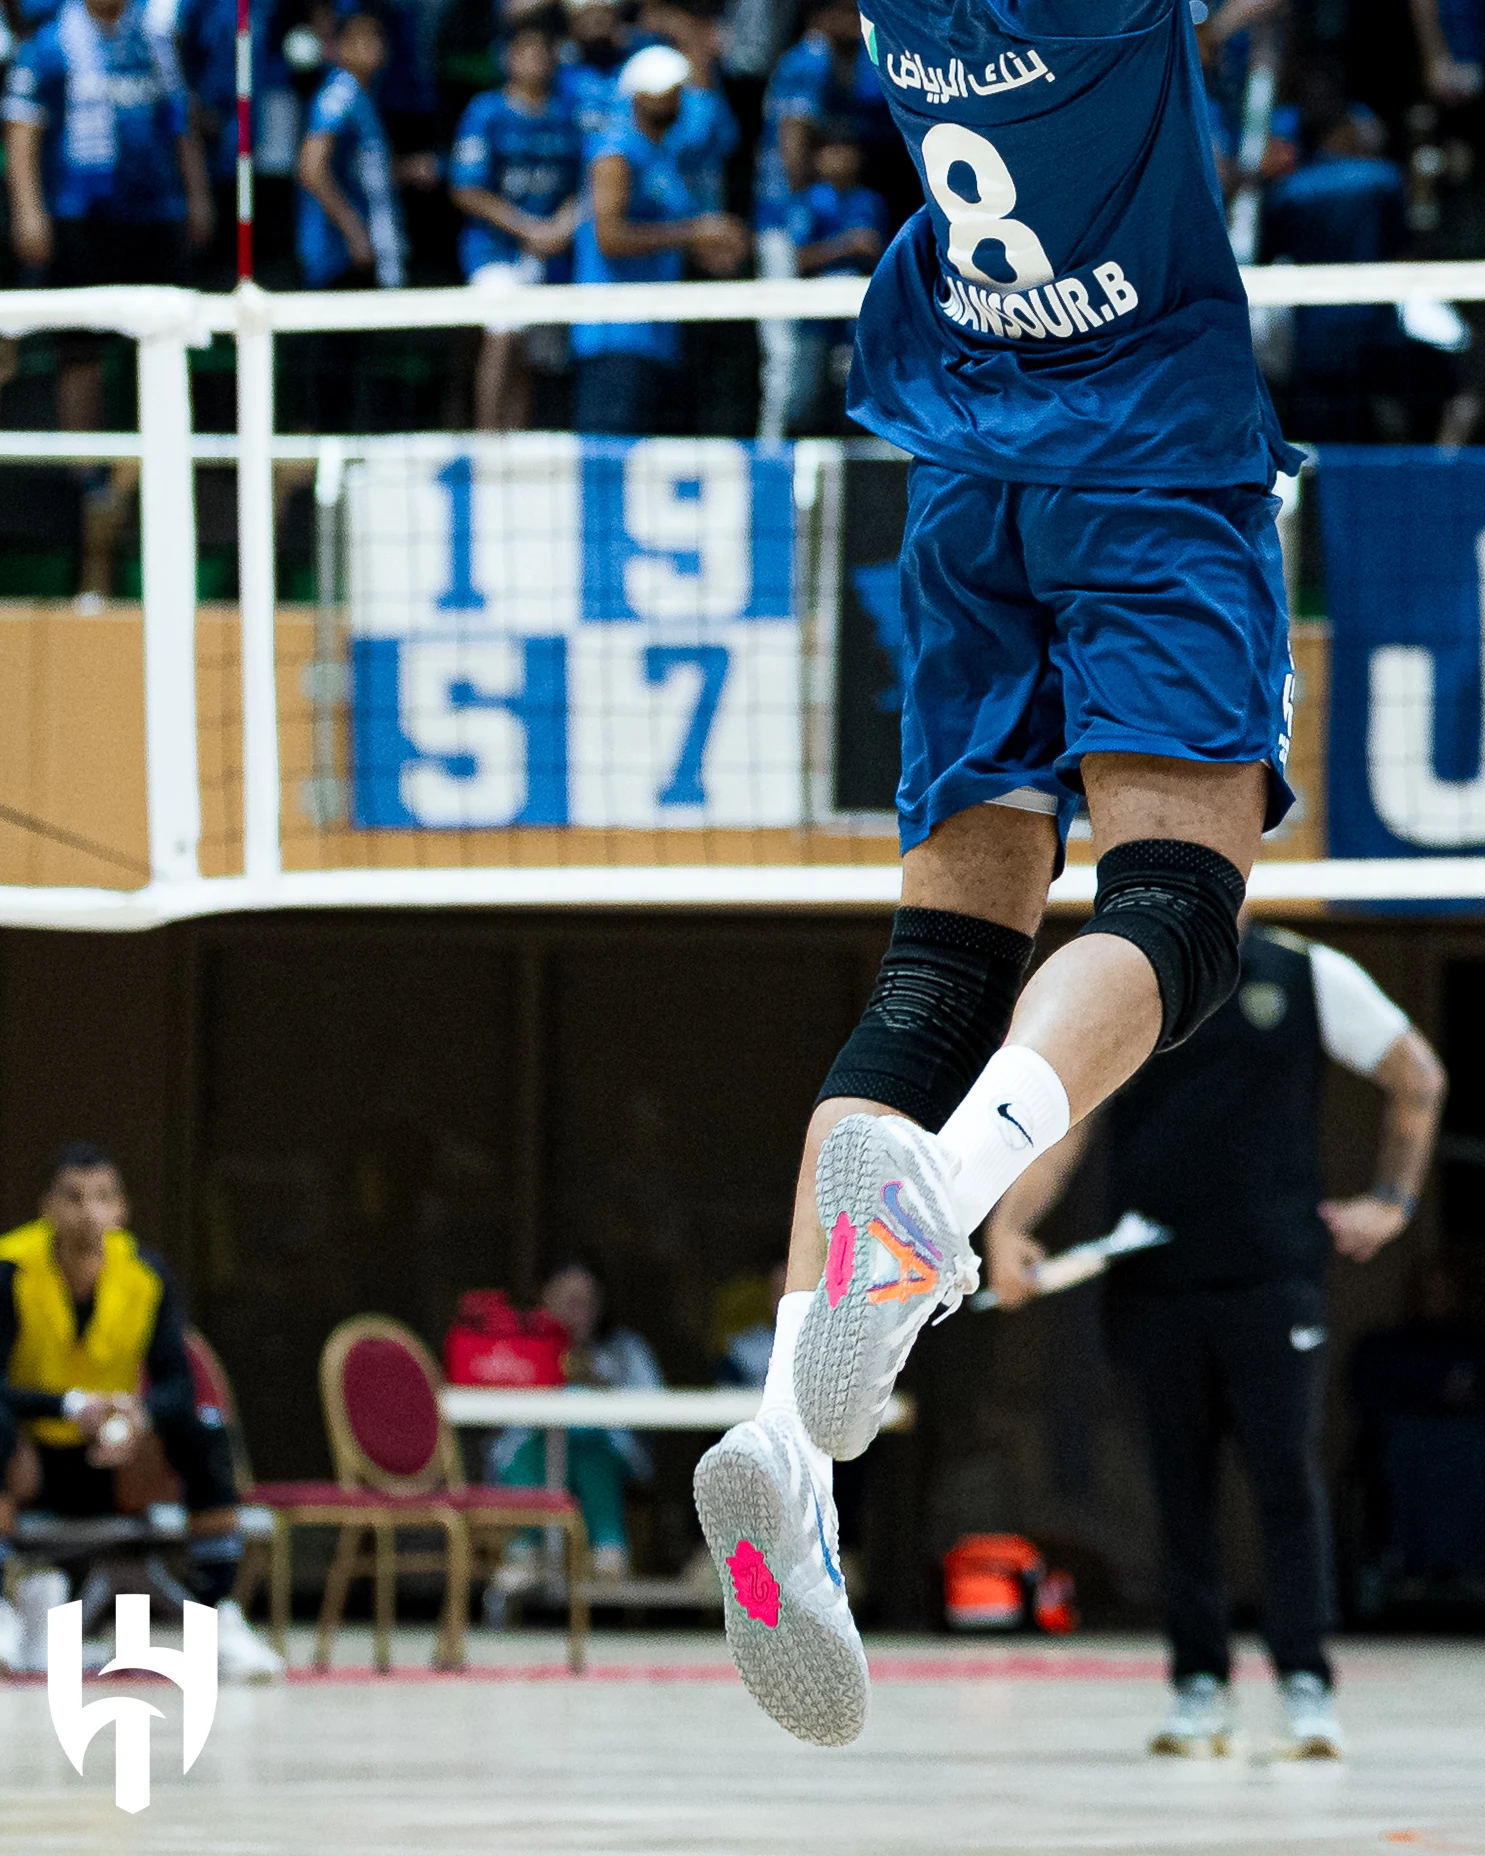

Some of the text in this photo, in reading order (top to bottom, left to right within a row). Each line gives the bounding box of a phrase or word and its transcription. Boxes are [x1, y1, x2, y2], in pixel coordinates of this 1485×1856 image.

[887, 49, 1055, 104] بنك الرياض
[921, 122, 1055, 293] 8
